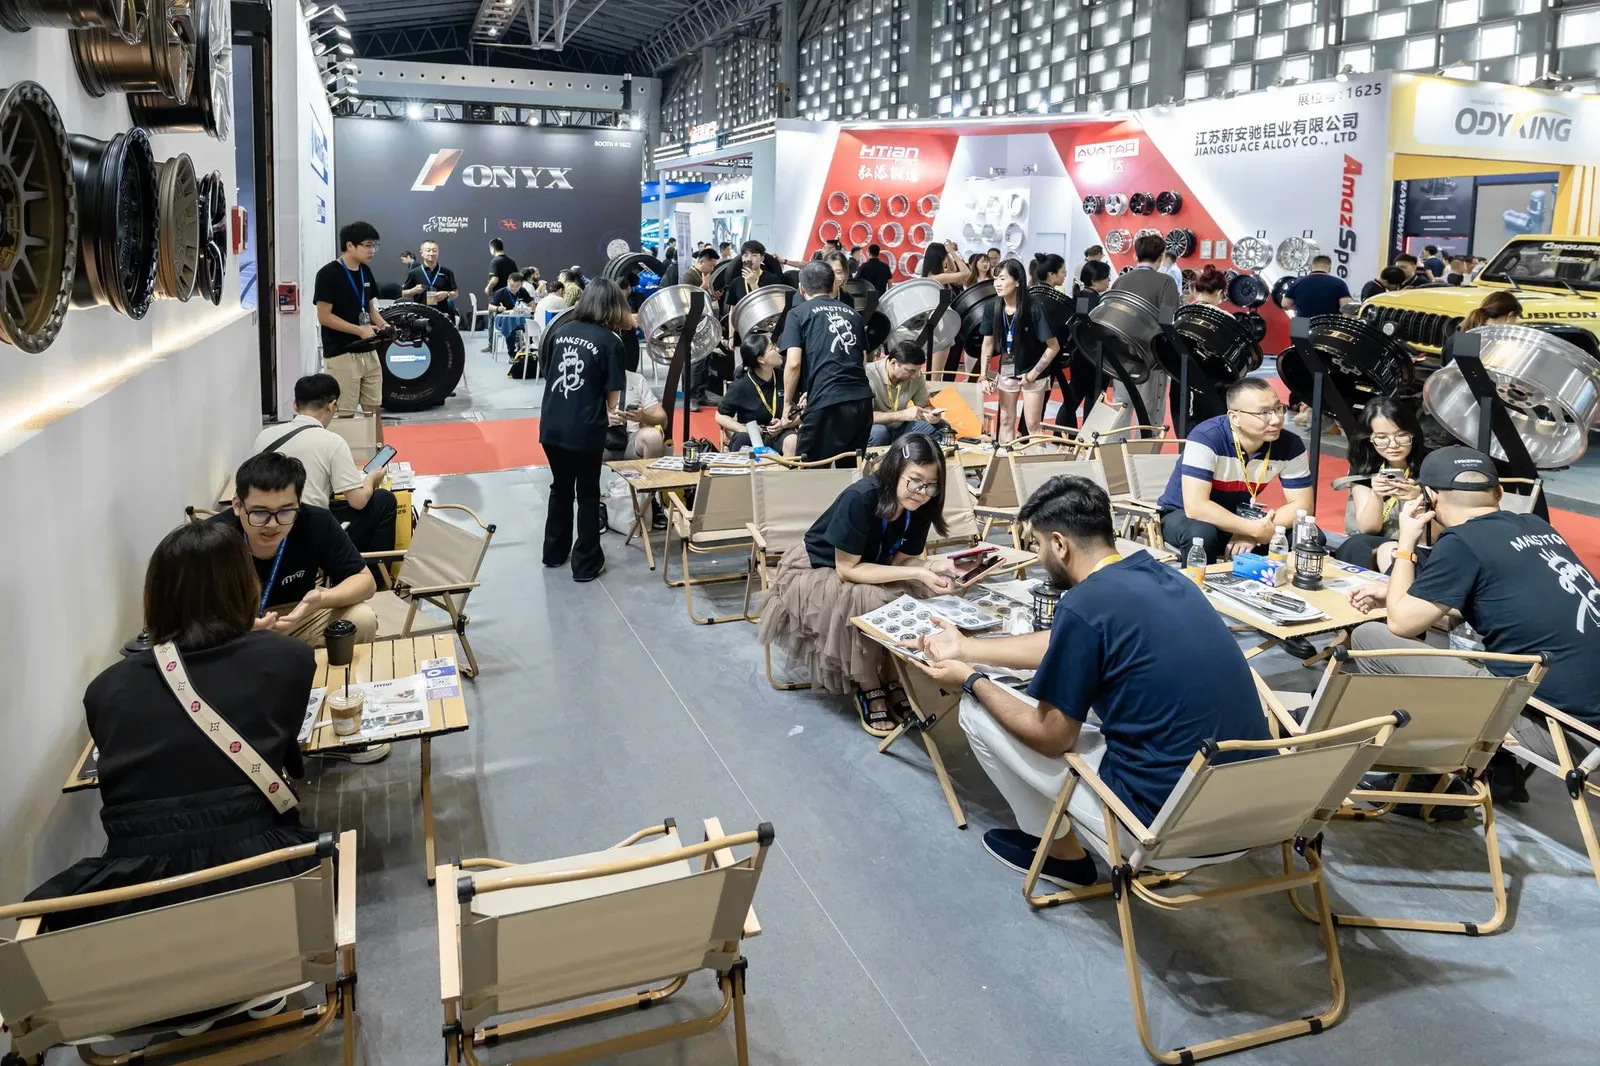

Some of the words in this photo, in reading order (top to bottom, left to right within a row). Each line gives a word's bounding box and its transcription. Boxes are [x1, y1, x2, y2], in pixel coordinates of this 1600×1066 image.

[1195, 112, 1359, 146] 江苏新安驰铝业有限公司
[1455, 107, 1572, 142] ODYKING
[1194, 143, 1237, 157] JIANGSU
[1239, 141, 1260, 153] ACE
[1263, 136, 1299, 150] ALLOY
[1333, 131, 1358, 143] LTD
[461, 164, 574, 190] ONYX
[522, 221, 562, 229] HENGFENG
[1519, 311, 1597, 320] UBICON
[555, 336, 599, 355] MAKSTTON
